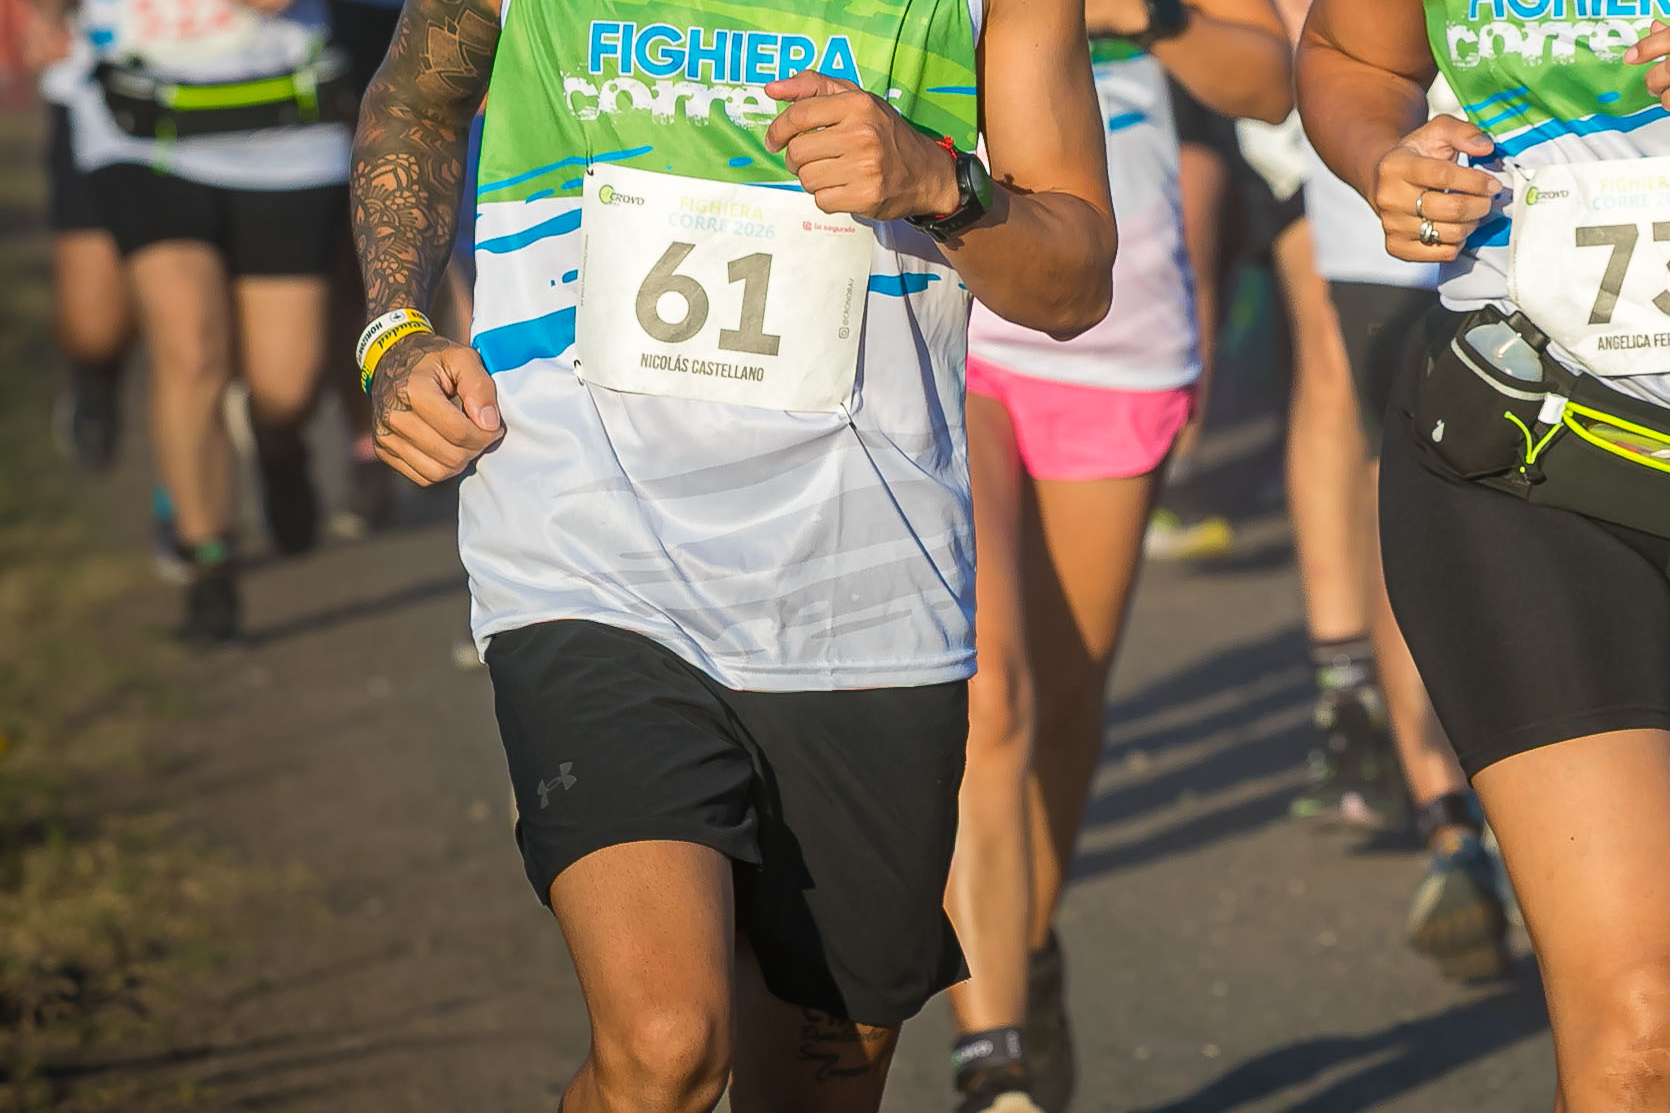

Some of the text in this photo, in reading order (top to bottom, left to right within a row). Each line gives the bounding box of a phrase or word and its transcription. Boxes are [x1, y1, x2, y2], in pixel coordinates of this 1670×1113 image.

[588, 19, 863, 88] FIGHIERA
[679, 196, 764, 221] FIGHIERA
[1592, 194, 1650, 211] CORRE
[668, 211, 776, 239] CORRE 2026
[635, 240, 781, 356] 61
[1598, 333, 1652, 351] ANGELICA
[640, 351, 764, 382] NICOLÁS CASTELLANO
